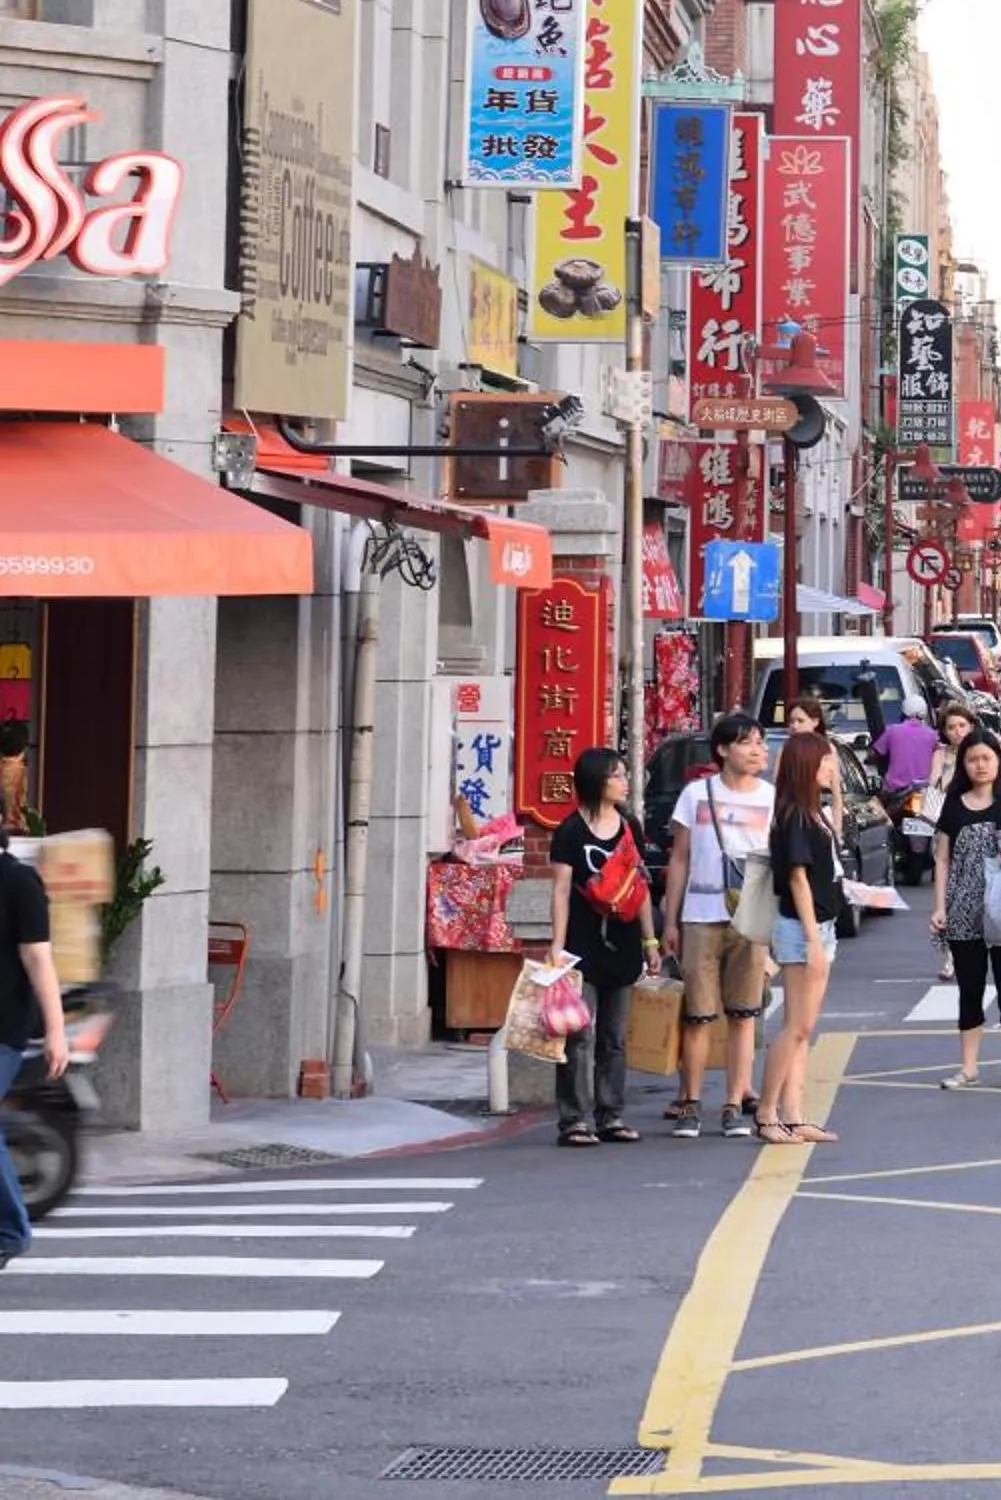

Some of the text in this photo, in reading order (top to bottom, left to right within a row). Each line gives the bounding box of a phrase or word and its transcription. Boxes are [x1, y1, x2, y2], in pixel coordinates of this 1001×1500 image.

[483, 88, 559, 114] 年貨
[482, 135, 559, 159] 批發
[279, 167, 335, 306] Coffee
